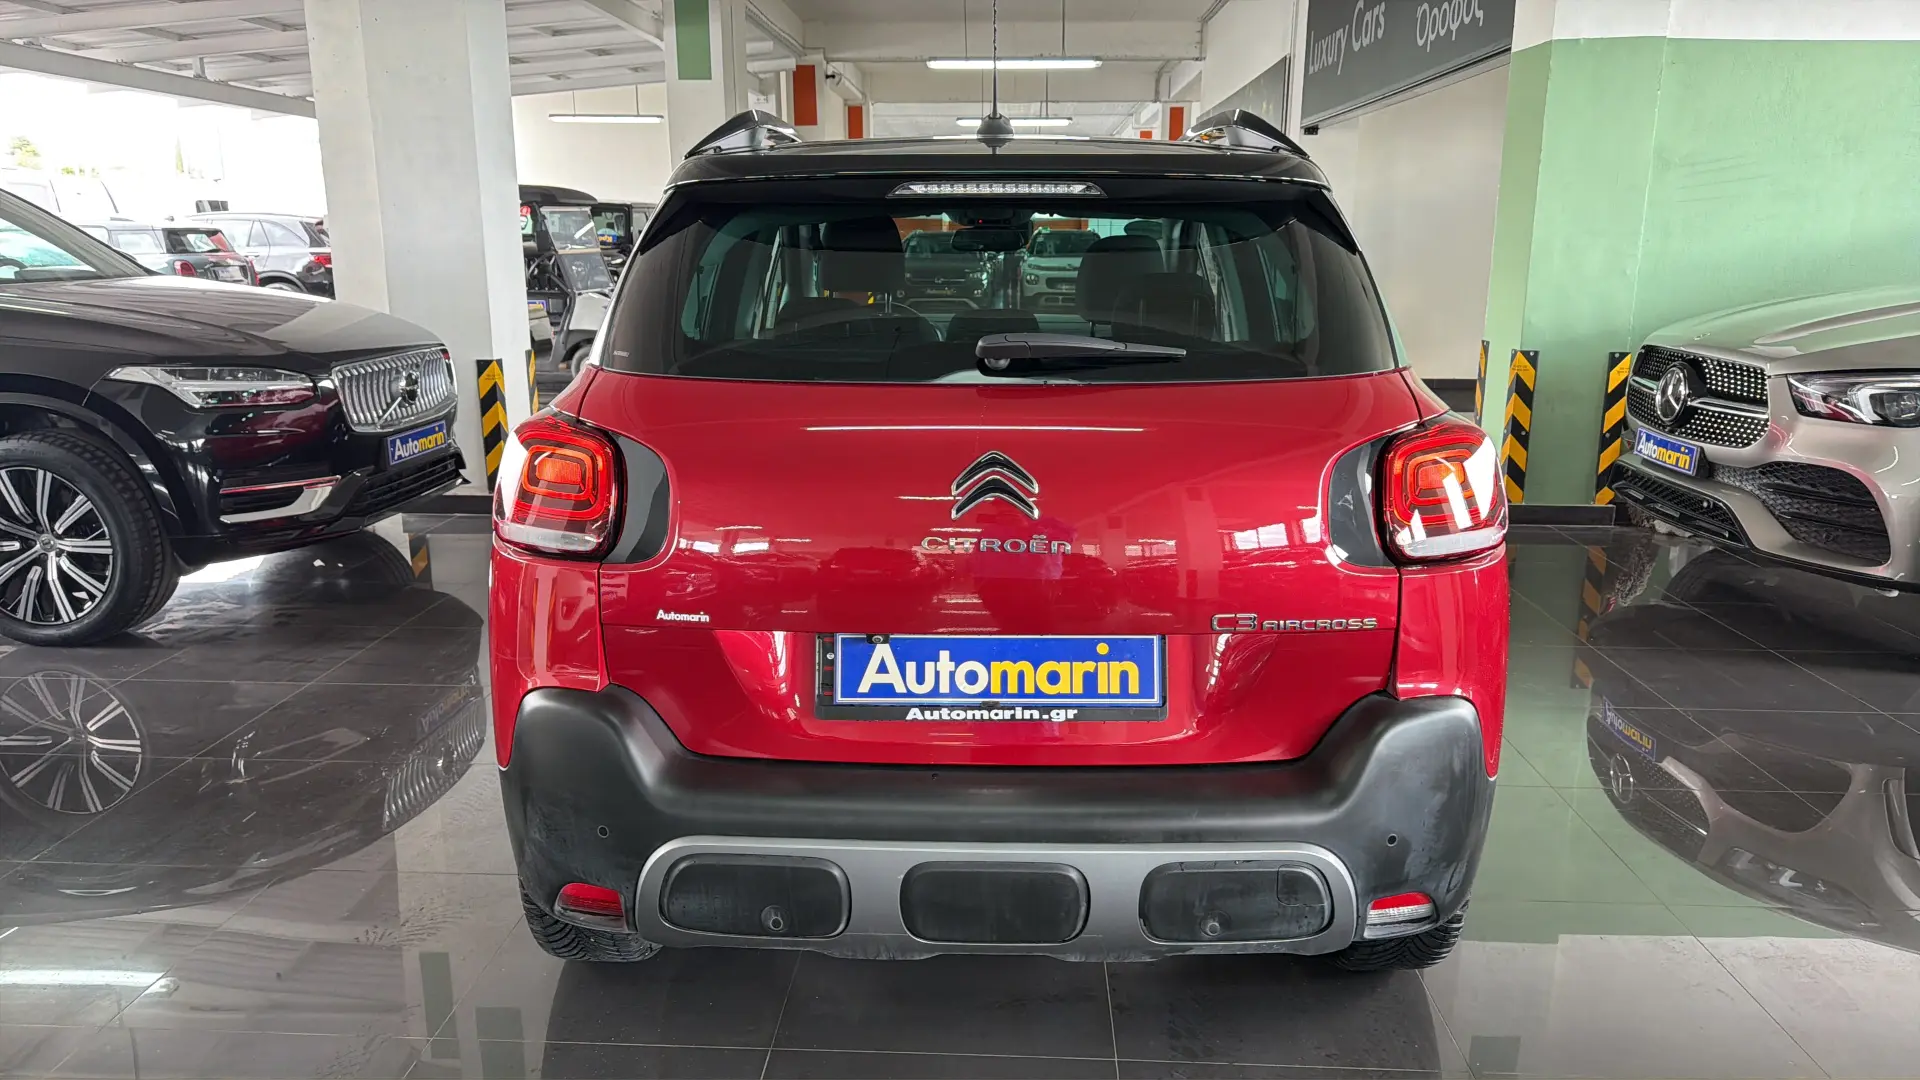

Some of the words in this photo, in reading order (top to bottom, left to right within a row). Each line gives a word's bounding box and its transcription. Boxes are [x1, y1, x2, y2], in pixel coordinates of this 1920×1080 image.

[1308, 24, 1349, 76] Luxury
[1352, 0, 1386, 52] Cars
[394, 425, 445, 461] Automarin
[1637, 432, 1690, 470] Automarin
[656, 609, 710, 622] Automarin
[1211, 613, 1258, 632] C3
[1262, 617, 1378, 631] AIRCROSS
[857, 642, 1140, 695] Automarin
[905, 707, 1078, 722] Automarin.gr
